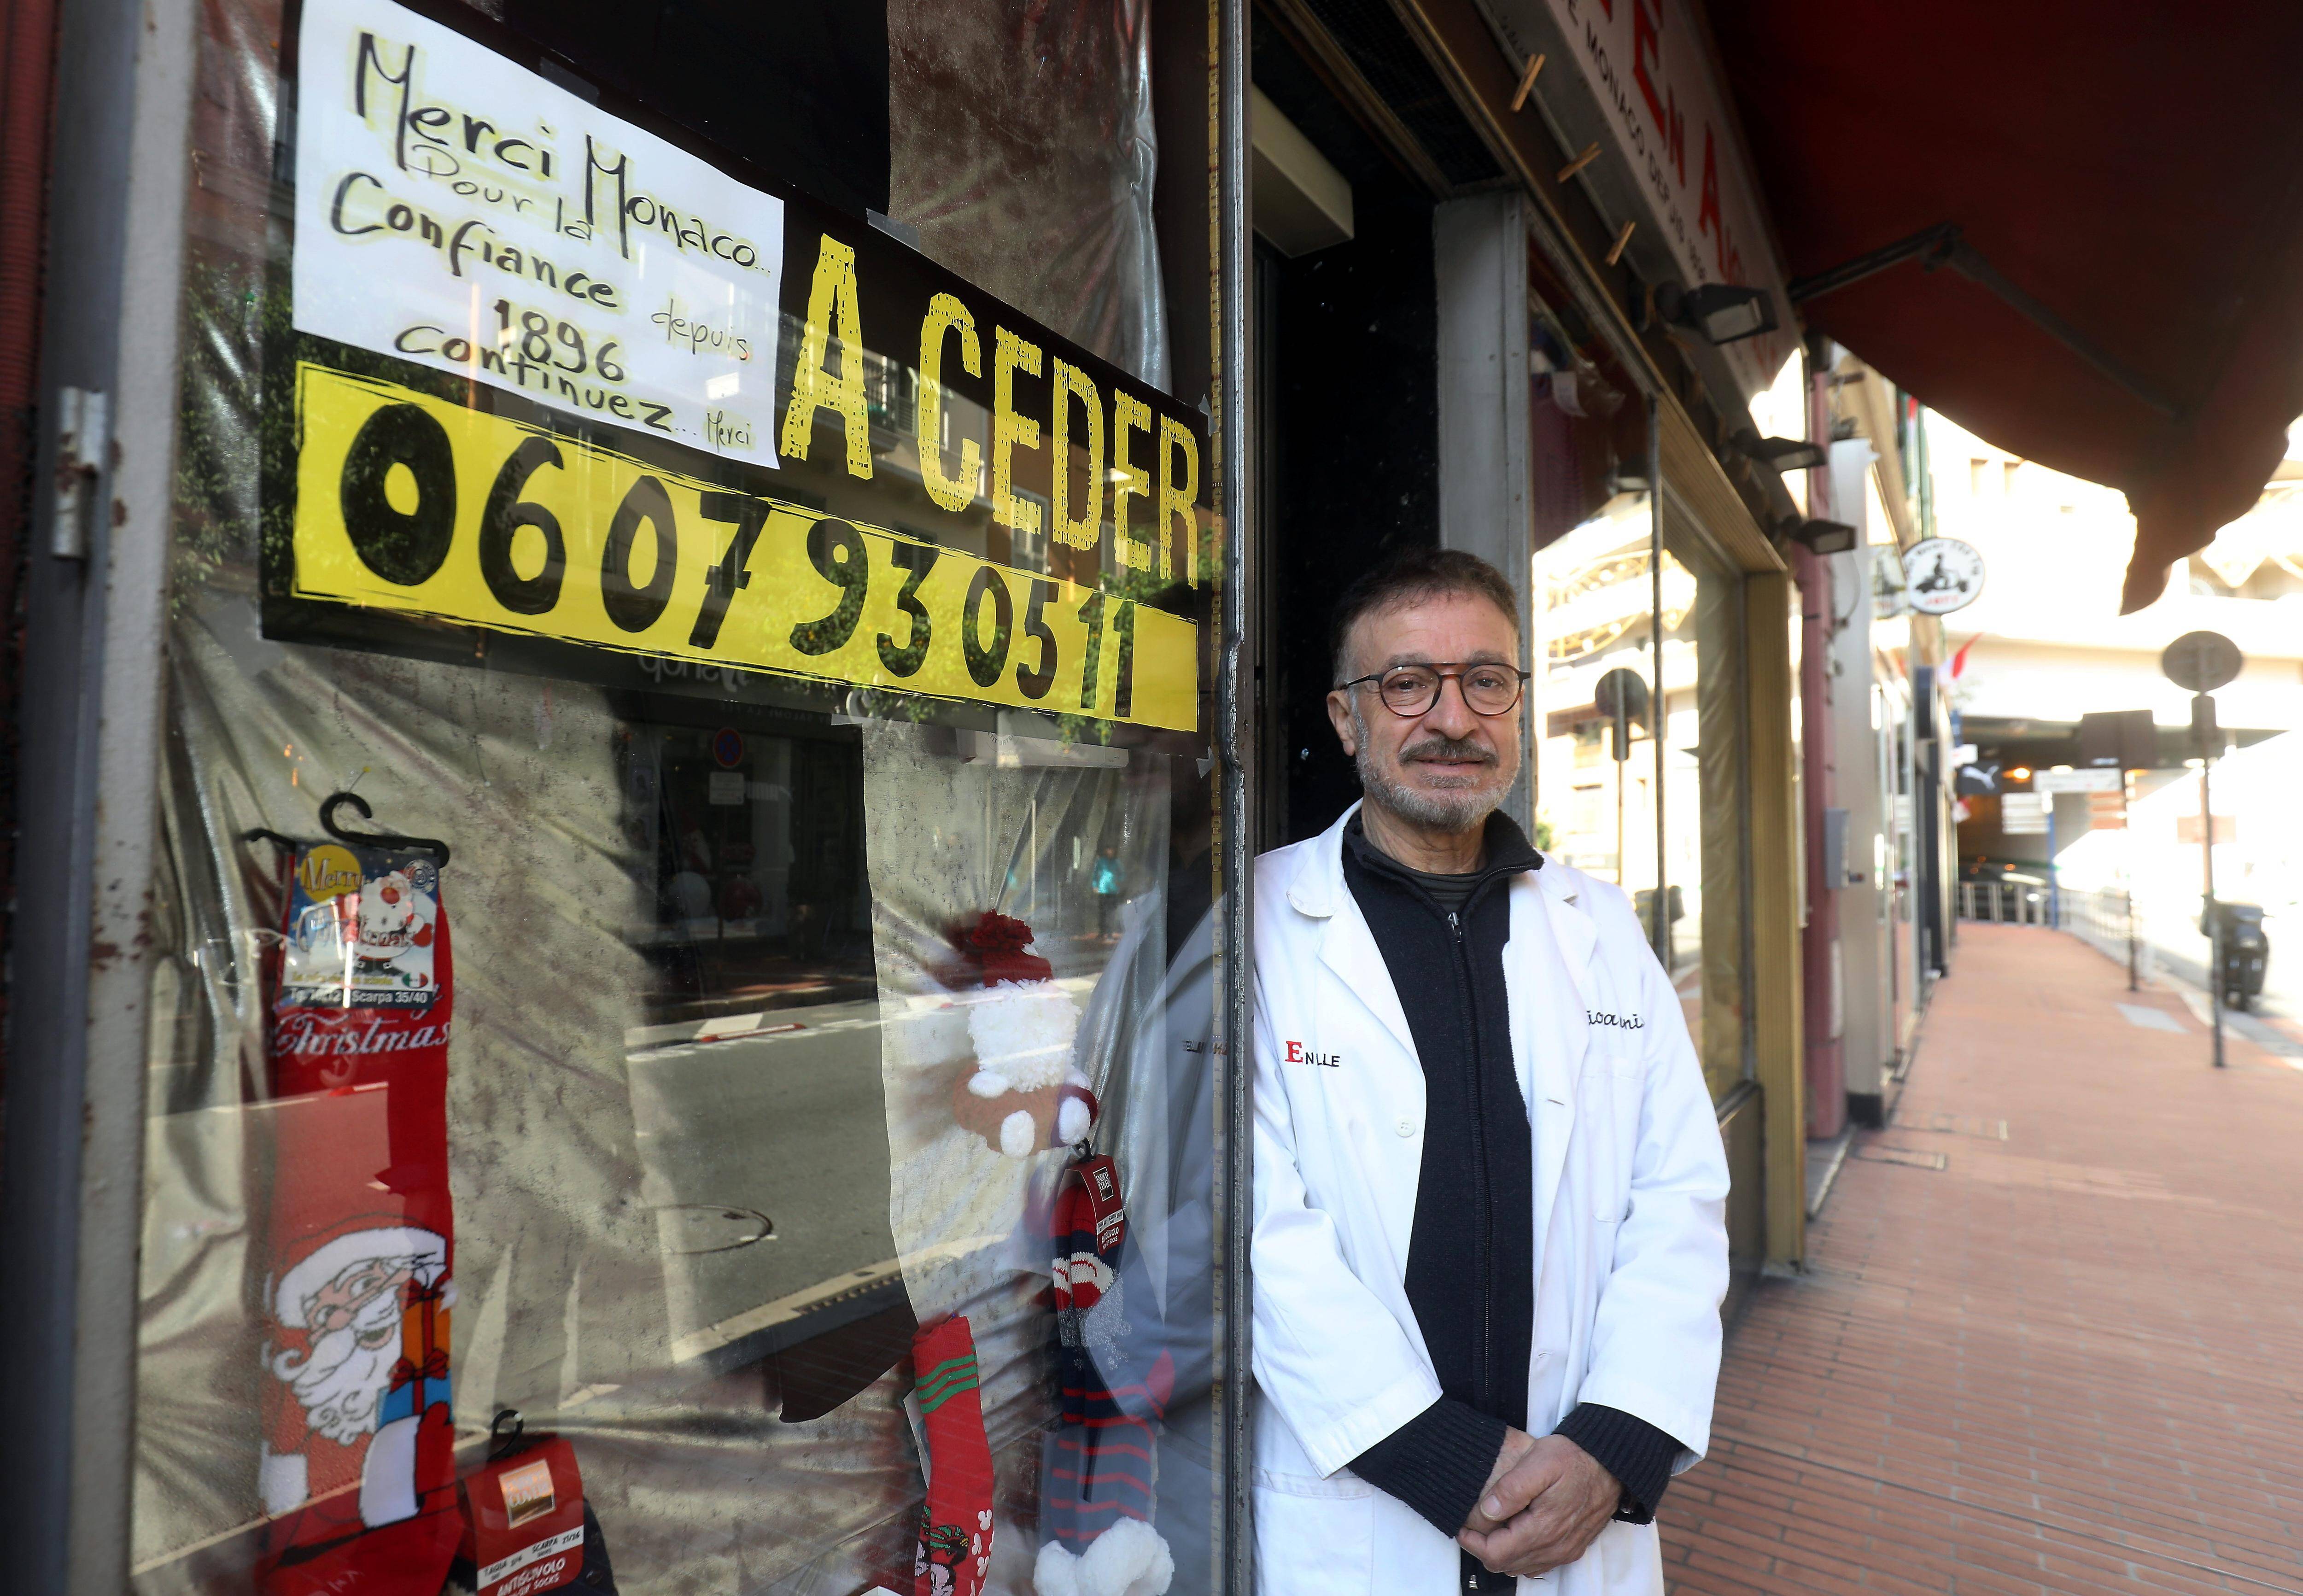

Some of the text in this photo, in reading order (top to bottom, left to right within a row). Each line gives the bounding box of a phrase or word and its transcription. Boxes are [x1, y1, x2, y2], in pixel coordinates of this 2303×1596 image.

[356, 31, 551, 178] Merci
[405, 144, 592, 242] Pour la
[330, 172, 619, 309] Confiance
[493, 298, 625, 383] 1896
[649, 297, 749, 361] depuis
[706, 410, 751, 453] Merci
[780, 233, 1199, 591] A CEDER
[271, 1011, 451, 1058] Christmas
[351, 990, 393, 1005] Scarpa
[395, 991, 428, 1004] 35/40
